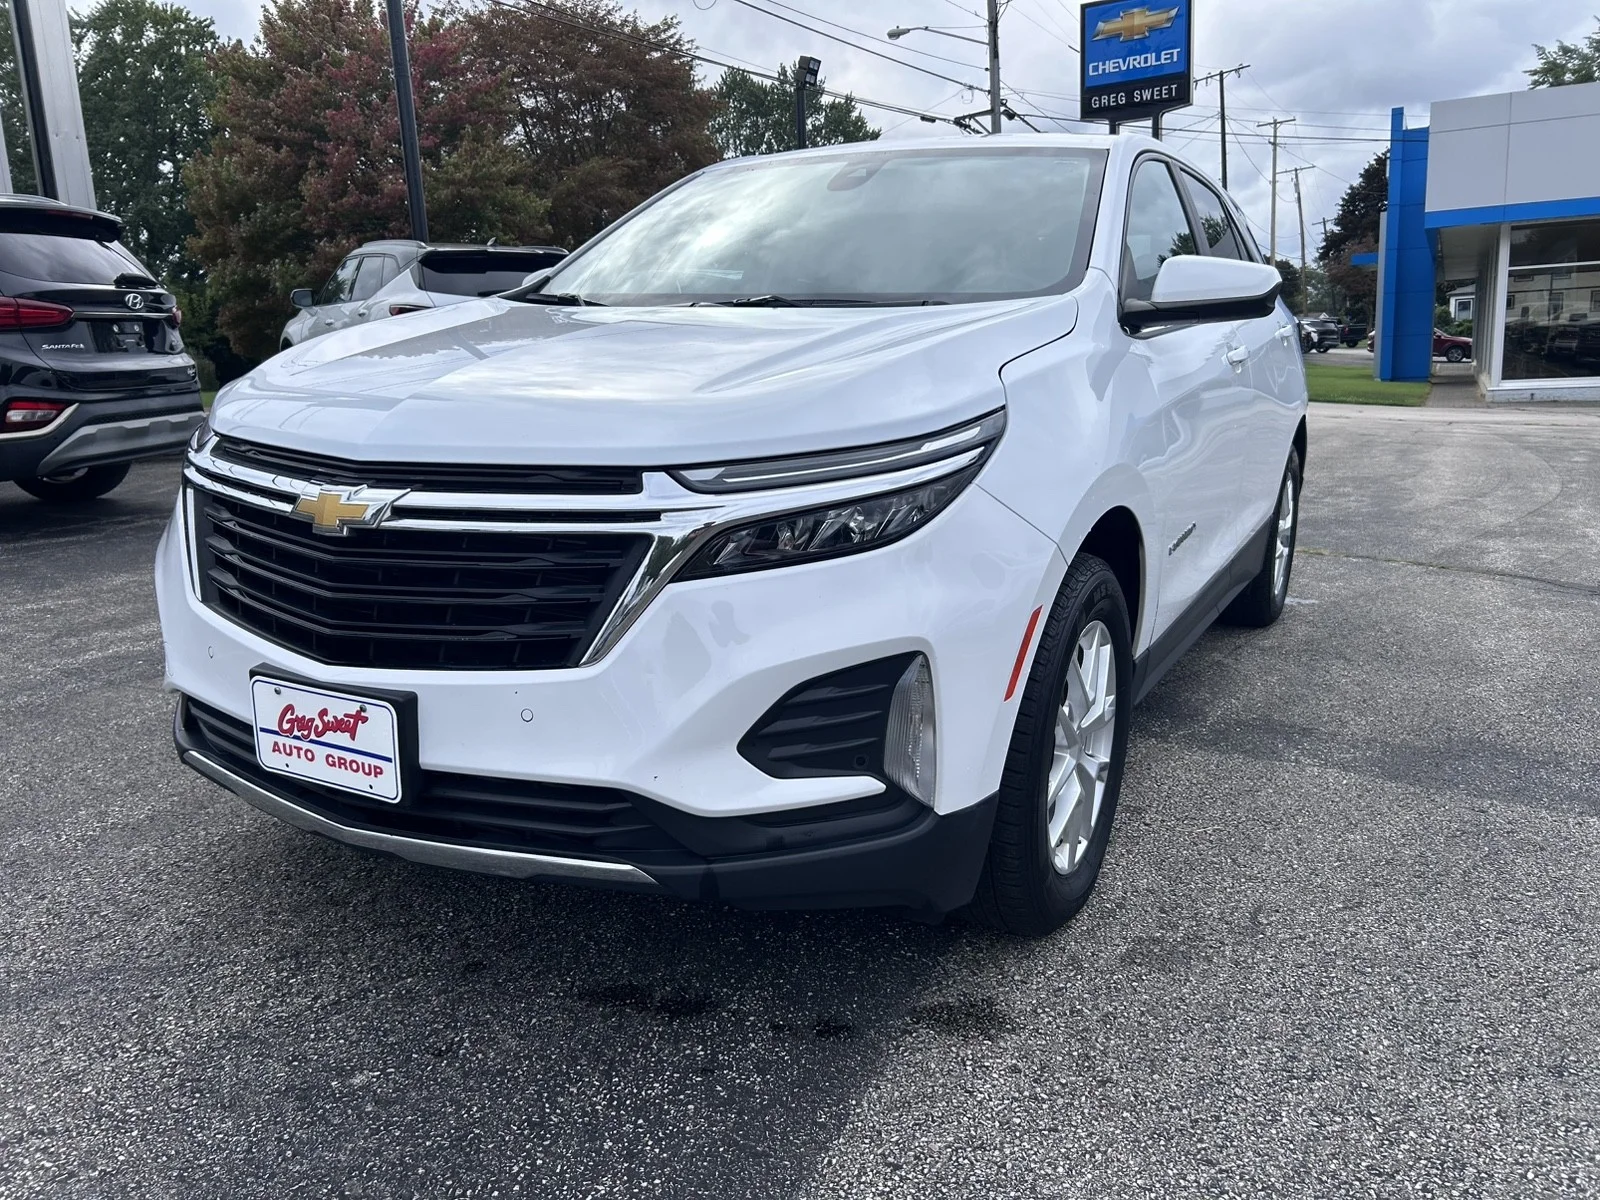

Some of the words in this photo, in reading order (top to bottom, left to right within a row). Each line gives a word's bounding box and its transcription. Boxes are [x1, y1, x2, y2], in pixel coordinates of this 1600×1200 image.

[1088, 48, 1181, 76] CHEVROLET
[1091, 92, 1126, 109] GREG
[1133, 84, 1178, 102] SWEET
[277, 703, 315, 741] Greg
[313, 707, 369, 742] Sweet
[271, 741, 315, 762] AUTO
[325, 753, 384, 778] GROUP
